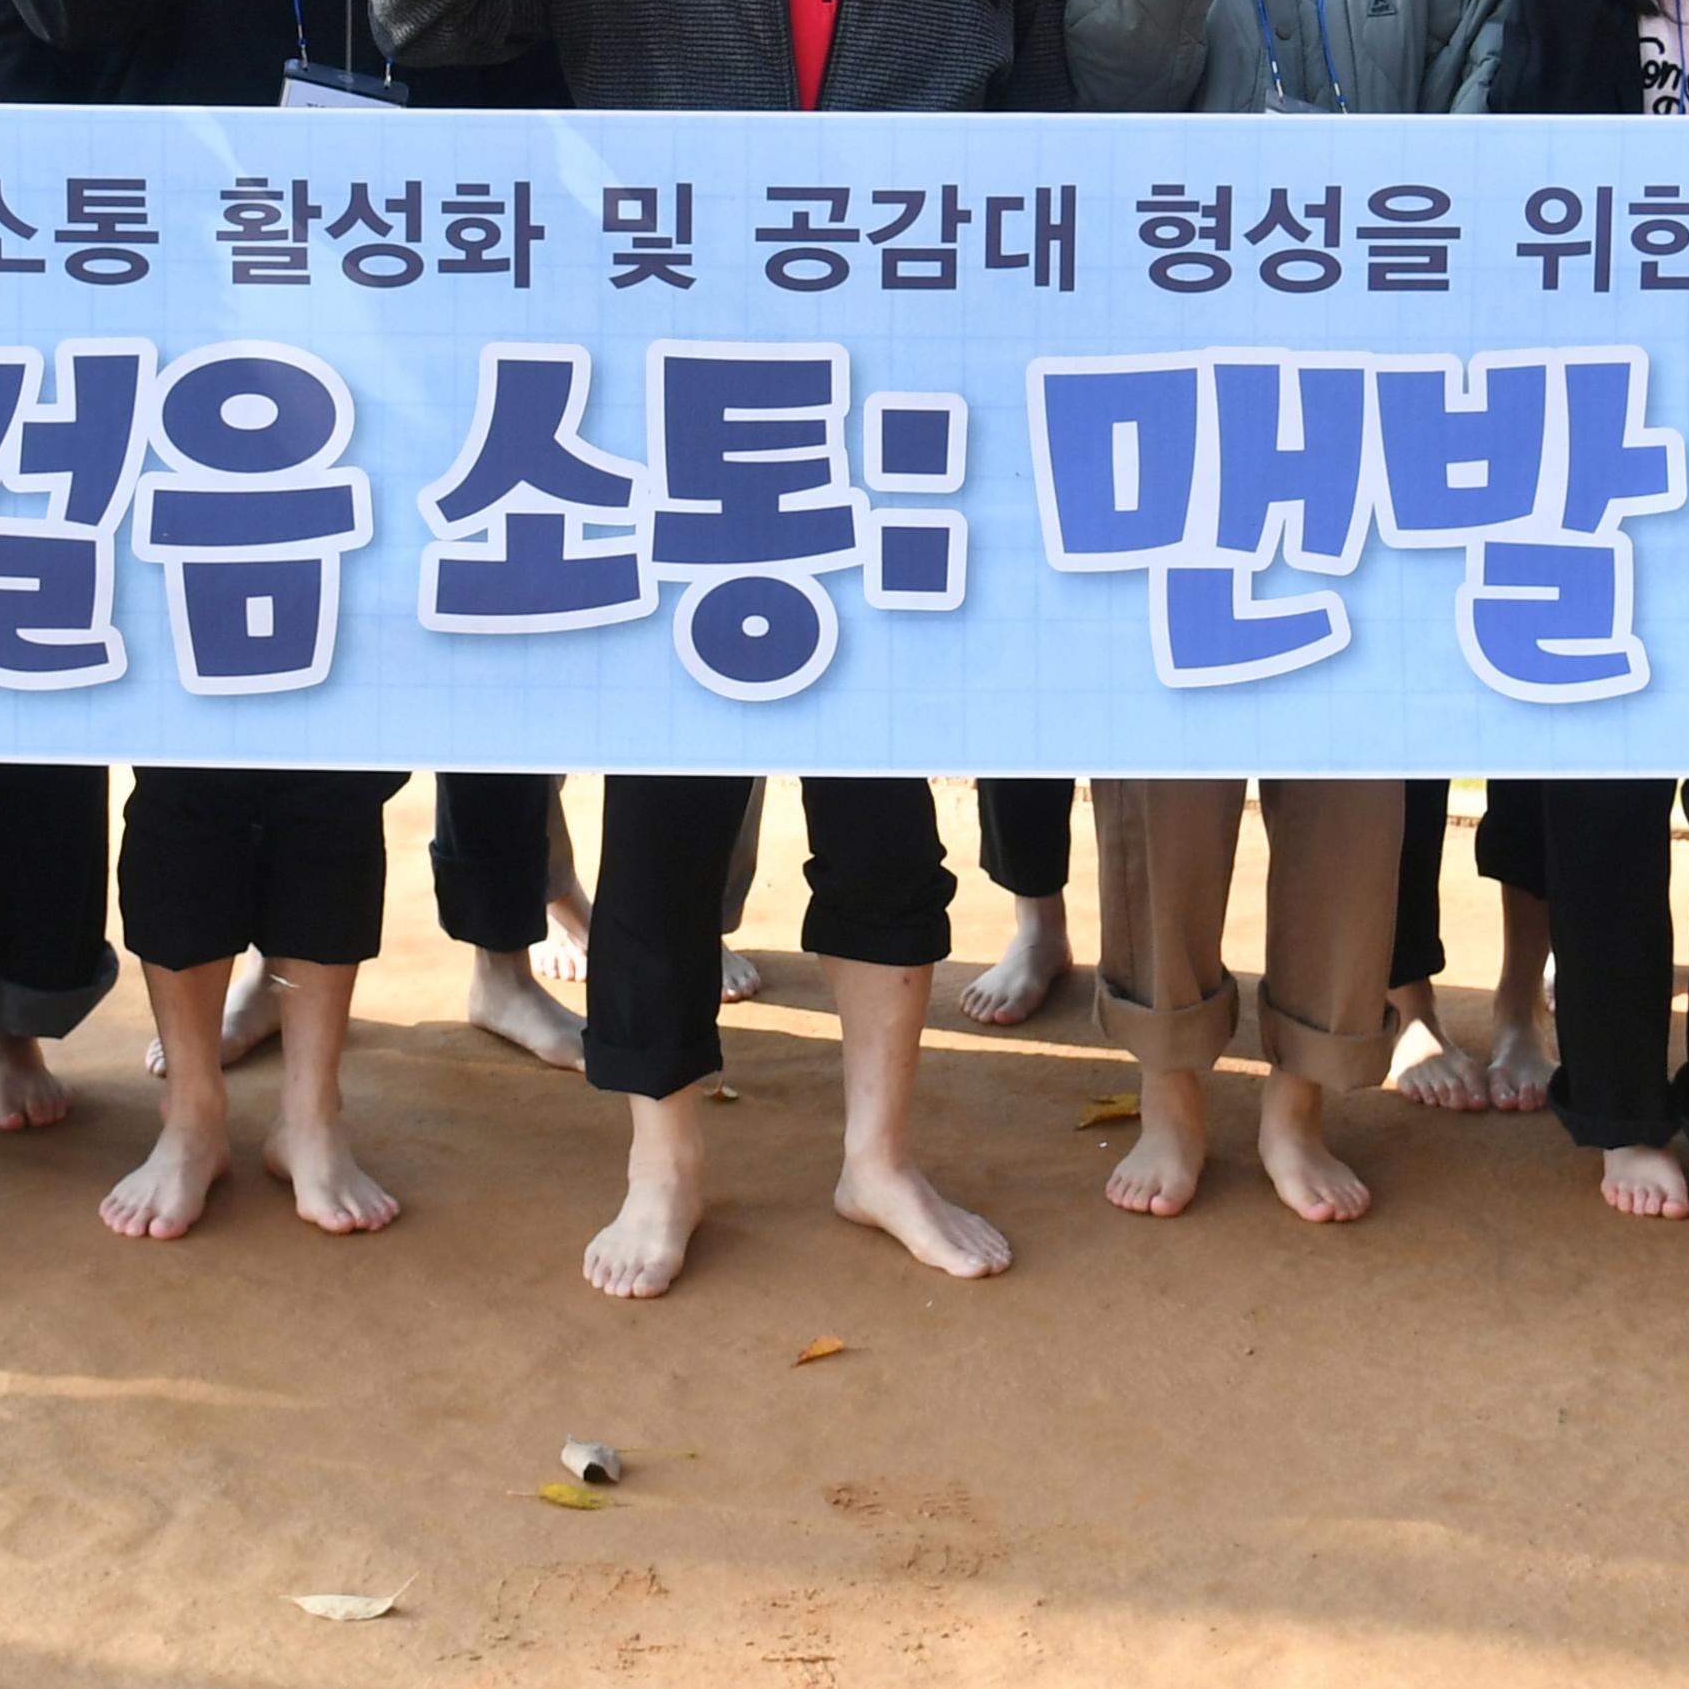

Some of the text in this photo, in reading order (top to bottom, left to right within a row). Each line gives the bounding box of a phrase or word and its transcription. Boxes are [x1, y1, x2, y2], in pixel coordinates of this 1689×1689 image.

[215, 176, 546, 290] 활성화
[601, 181, 698, 291] 및
[753, 183, 1078, 294] 공감대
[1134, 183, 1462, 295] 형성을
[426, 352, 954, 687] 소통:
[1039, 359, 1672, 688] 맨발
